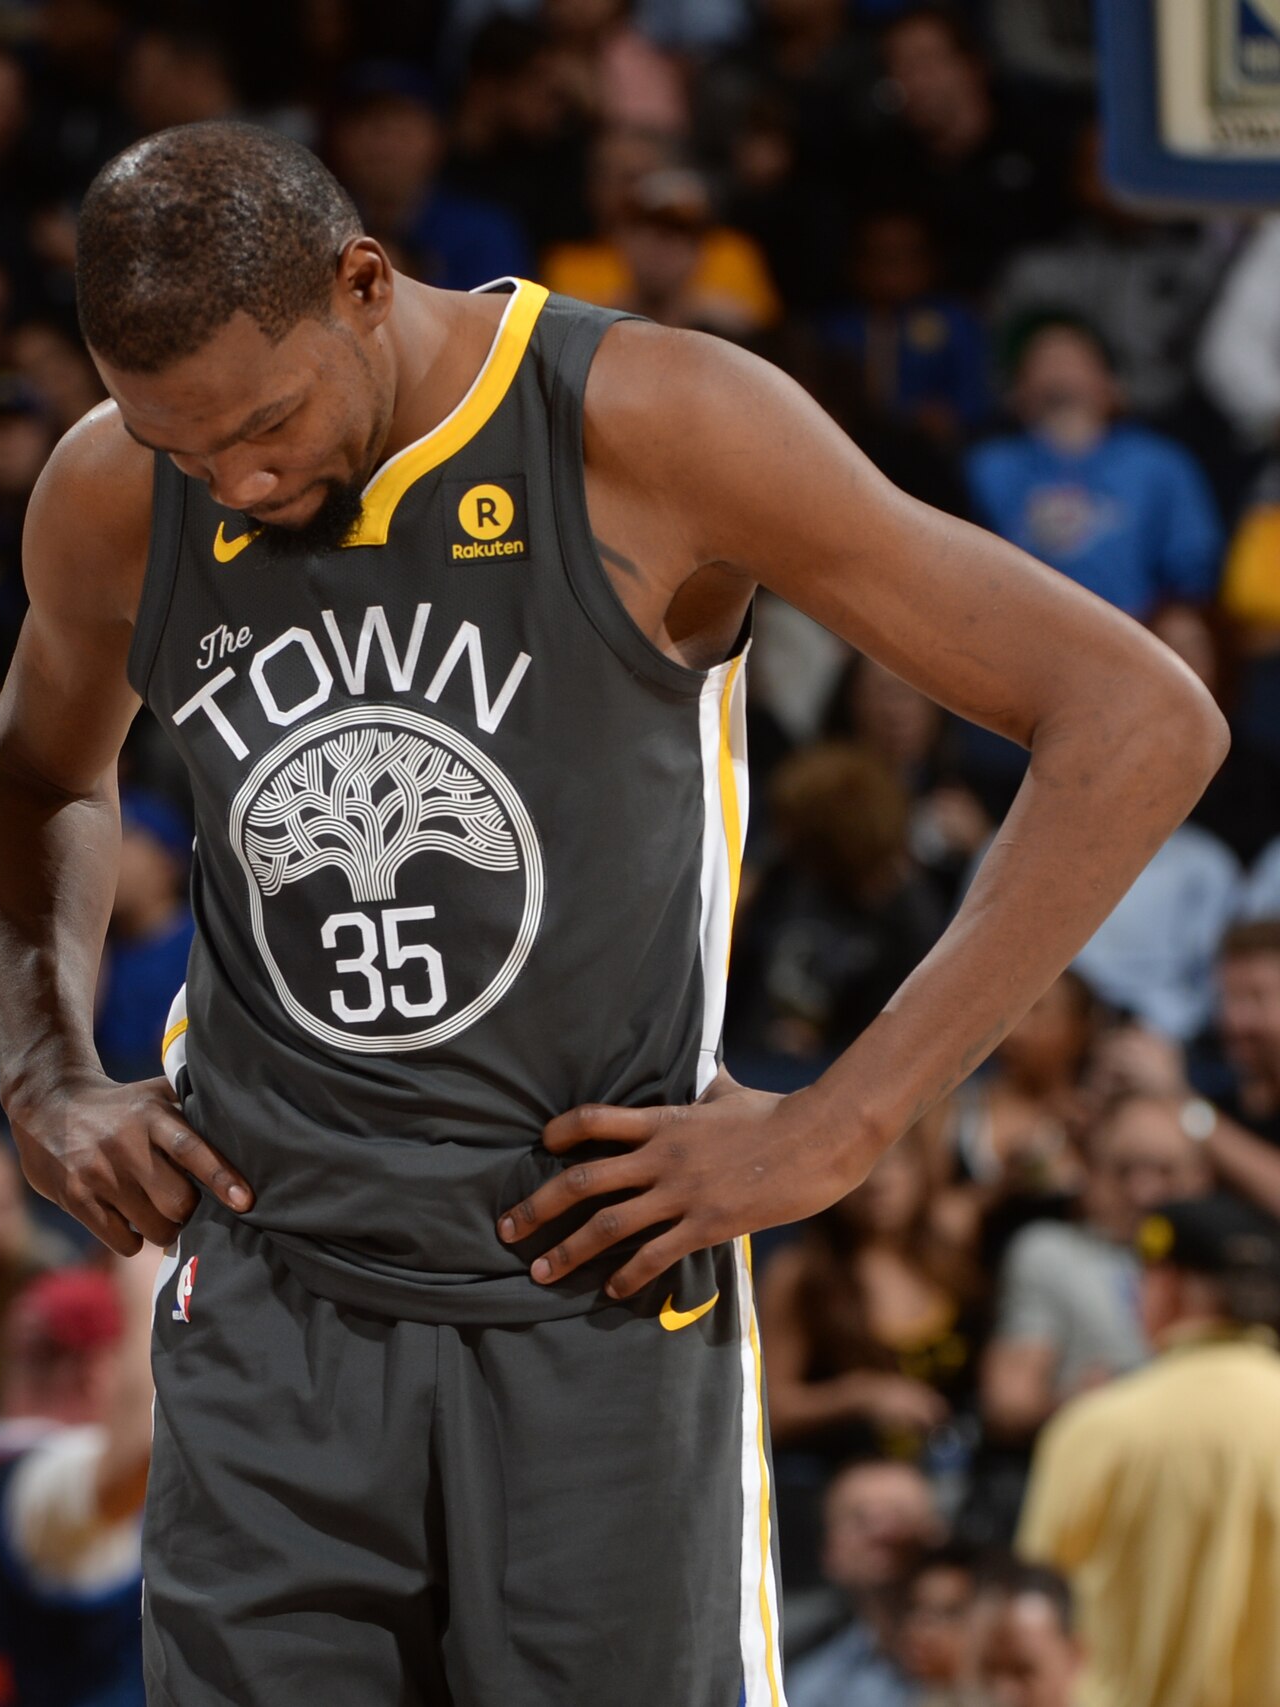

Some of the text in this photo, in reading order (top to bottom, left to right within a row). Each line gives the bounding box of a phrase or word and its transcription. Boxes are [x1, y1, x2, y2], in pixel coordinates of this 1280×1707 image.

[476, 497, 501, 528] R
[452, 540, 524, 560] Rakuten
[196, 623, 253, 670] The
[171, 603, 532, 761] TOWN
[321, 905, 448, 1024] 35
